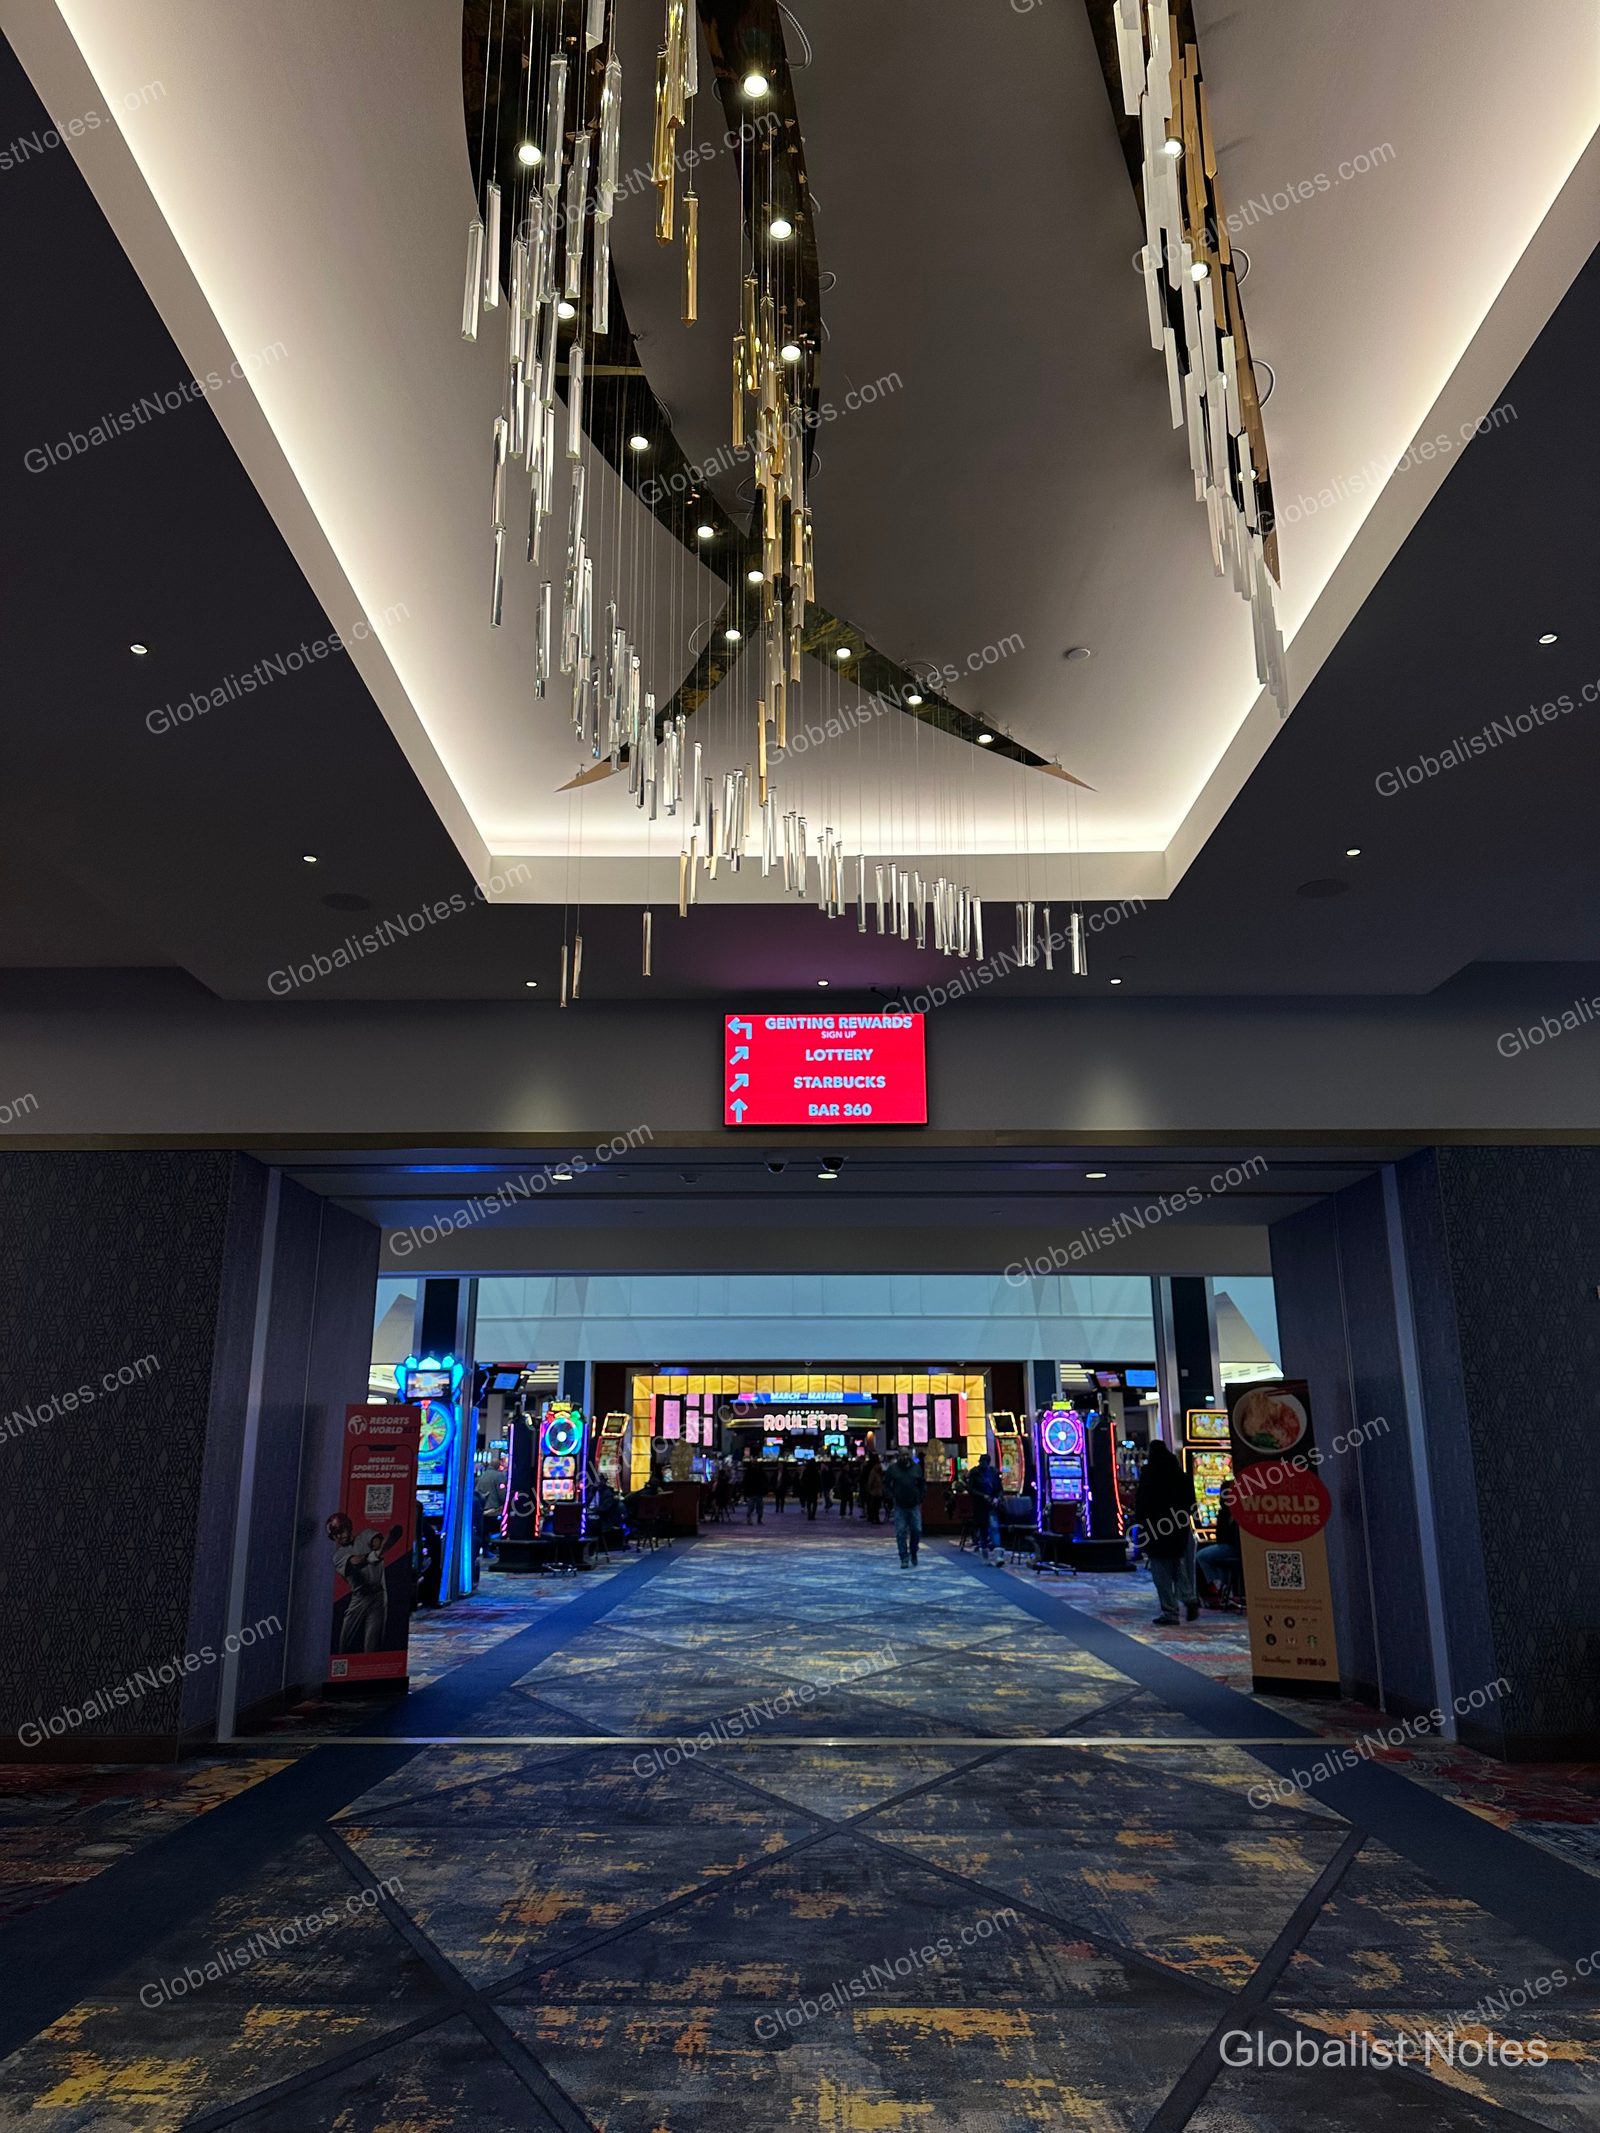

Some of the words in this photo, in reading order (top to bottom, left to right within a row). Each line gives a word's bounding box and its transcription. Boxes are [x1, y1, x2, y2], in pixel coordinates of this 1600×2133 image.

[765, 1017, 835, 1030] GENTING
[839, 1016, 912, 1029] REWARDS
[821, 1031, 843, 1039] SIGN
[844, 1031, 857, 1039] UP
[805, 1049, 873, 1061] LOTTERY
[793, 1076, 886, 1089] STARBUCKS
[808, 1104, 839, 1116] BAR
[843, 1104, 872, 1116] 360
[369, 1416, 410, 1425] RESORTS
[763, 1414, 848, 1431] ROULETTE
[369, 1425, 404, 1434] WORLD
[368, 1456, 396, 1464] MOBILE
[1241, 1495, 1320, 1512] WORLD
[1257, 1514, 1320, 1525] FLAVORS
